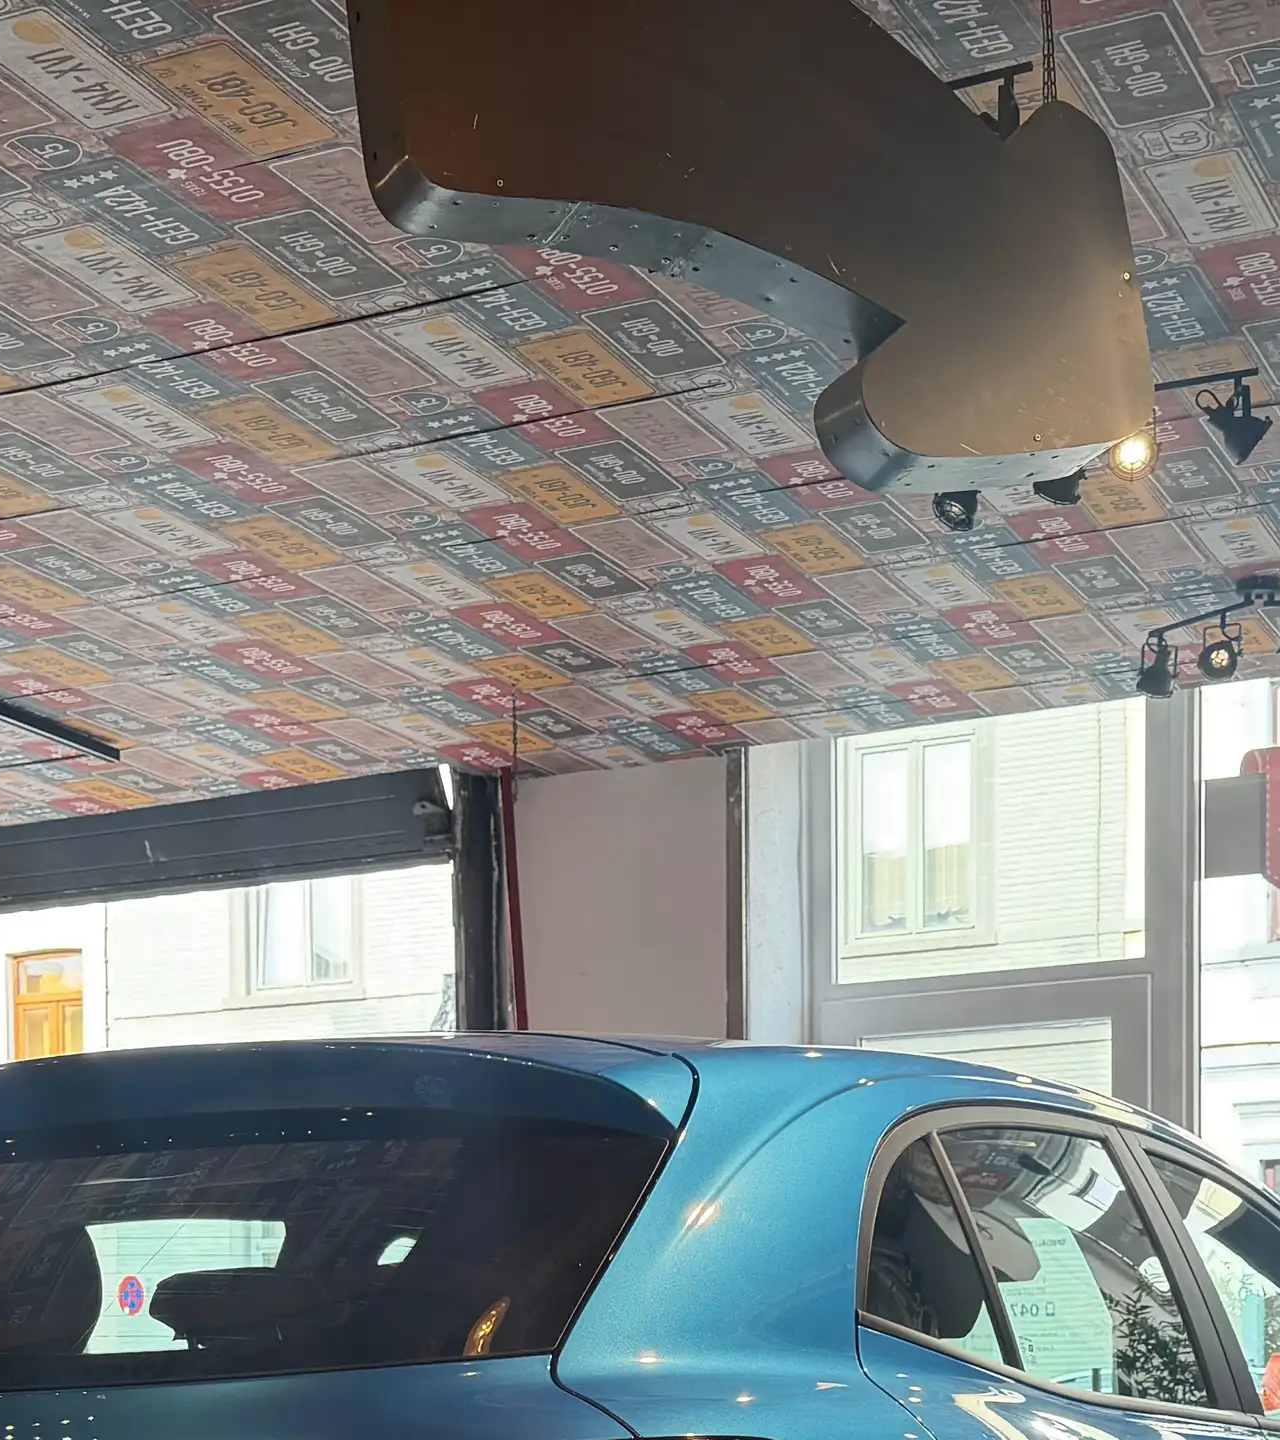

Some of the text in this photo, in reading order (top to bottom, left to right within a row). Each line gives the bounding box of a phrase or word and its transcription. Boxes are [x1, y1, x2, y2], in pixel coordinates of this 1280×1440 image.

[20, 47, 145, 115] KN4-XV1
[31, 141, 74, 158] 15
[176, 179, 210, 196] TEXAS
[1180, 178, 1255, 233] KN4-XV1
[85, 183, 207, 246] GEH-142A
[417, 243, 455, 257] 15
[69, 251, 175, 301] KN4-XV1
[122, 352, 226, 399] GEH-142A
